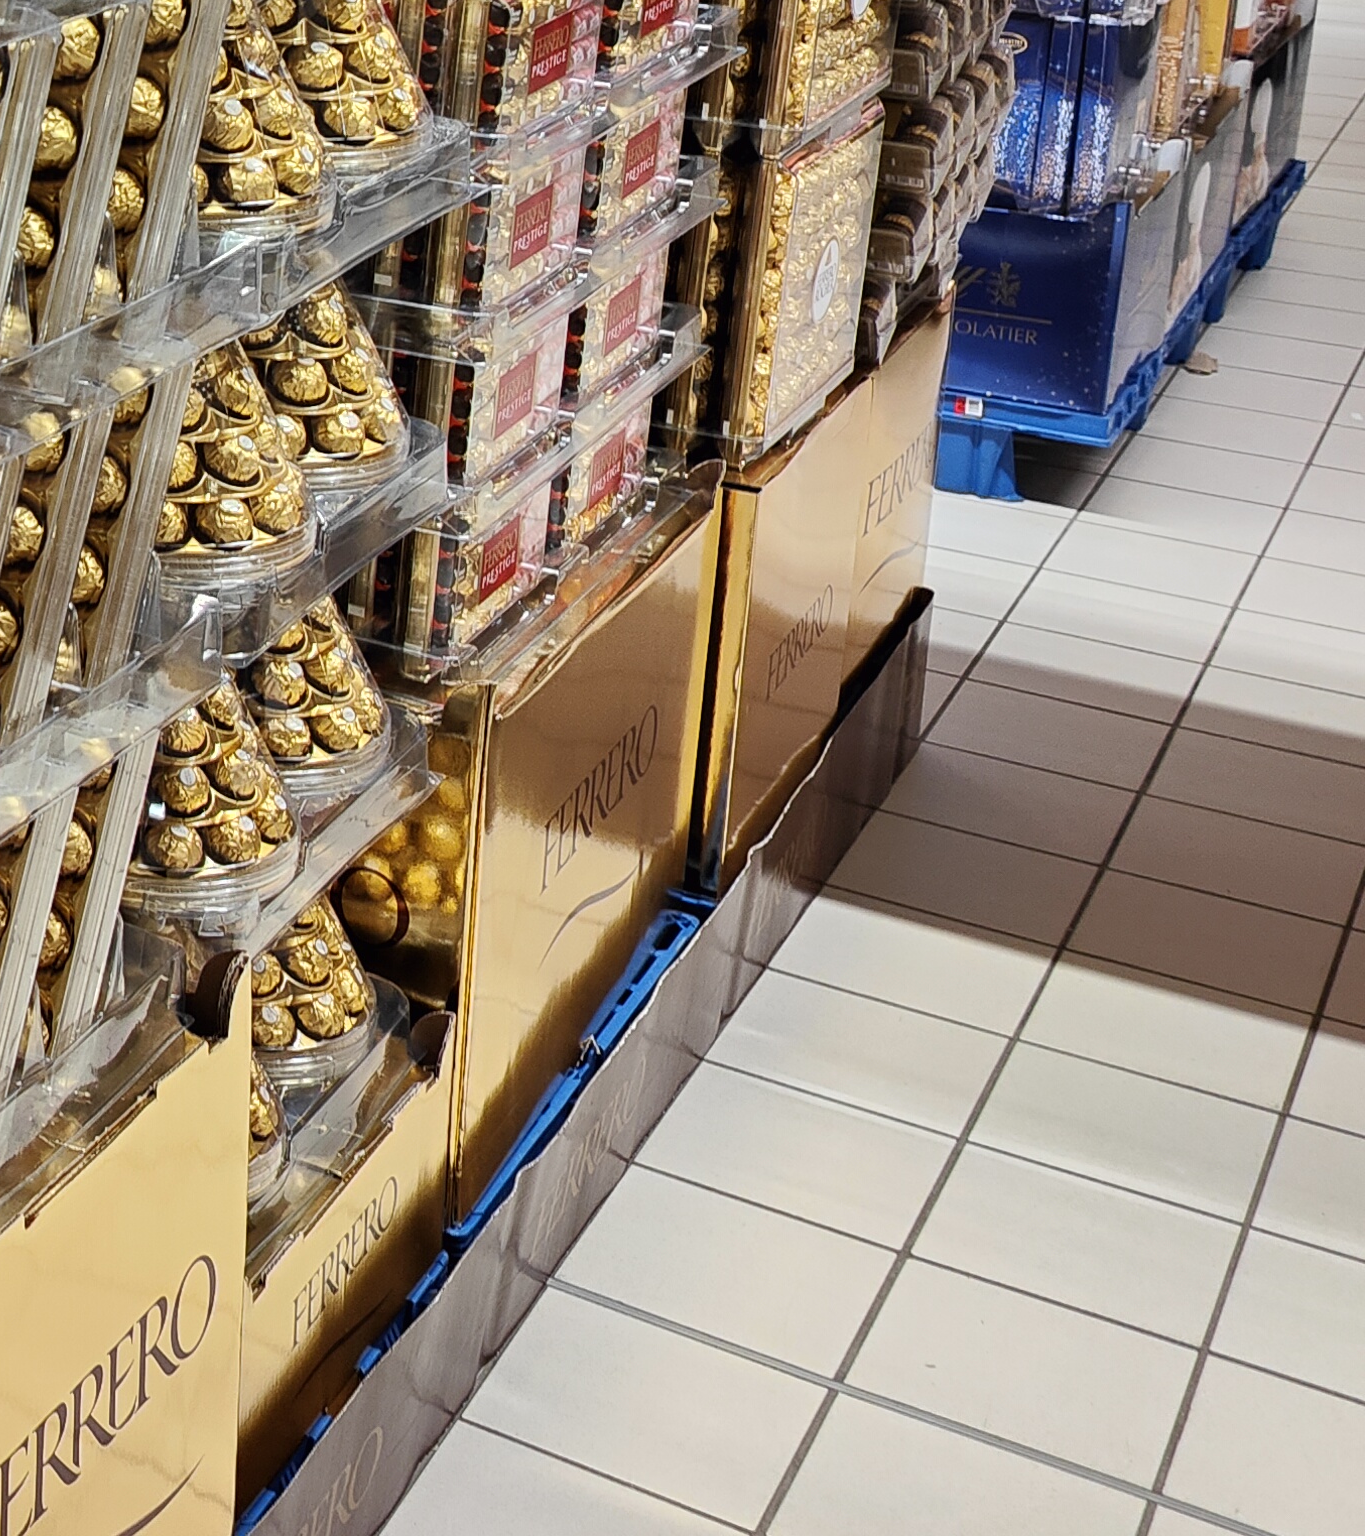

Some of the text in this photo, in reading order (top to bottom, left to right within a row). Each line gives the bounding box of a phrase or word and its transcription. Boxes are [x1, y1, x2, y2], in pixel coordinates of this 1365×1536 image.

[531, 52, 567, 77] PRESTIGE
[624, 157, 656, 184] PRESTIGE
[512, 222, 548, 255] PRESTIGE
[606, 312, 638, 346] PRESTIGE
[496, 390, 533, 426] PRESTIGE
[591, 464, 622, 498] PRESTIGE
[481, 552, 517, 589] PRESTIGE
[766, 584, 834, 700] FERRERO
[540, 705, 659, 894] FERRERO
[290, 1175, 400, 1349] FERRERO
